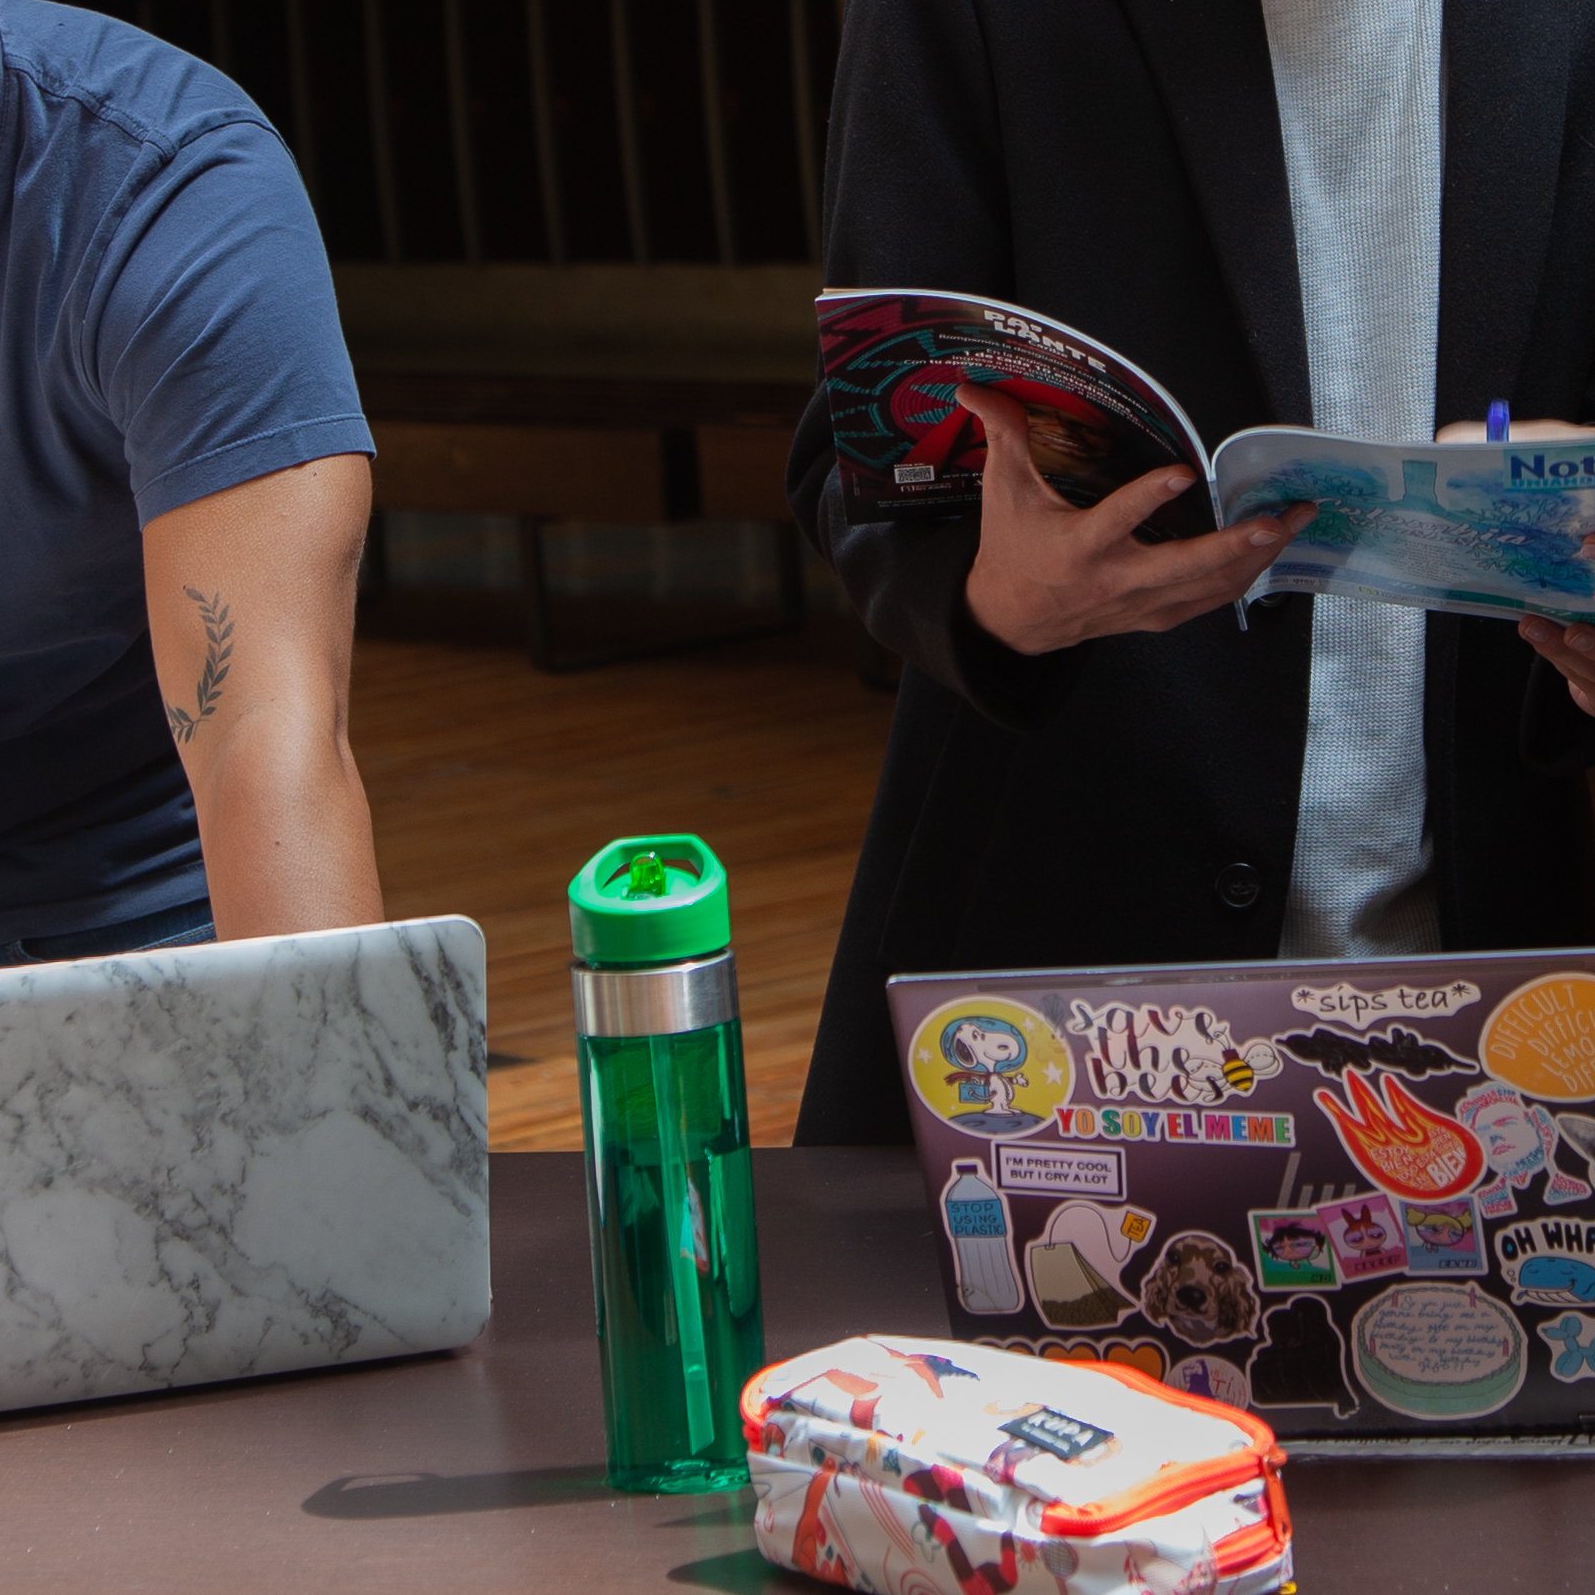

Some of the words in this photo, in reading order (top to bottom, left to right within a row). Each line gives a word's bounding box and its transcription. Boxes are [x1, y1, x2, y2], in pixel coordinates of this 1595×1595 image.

[1072, 1004, 1214, 1045] save
[1490, 984, 1576, 1060] DIFFICULT
[1056, 1108, 1094, 1135] YO
[1102, 1109, 1161, 1138] SOY
[1167, 1113, 1199, 1139] EL
[1205, 1114, 1292, 1144] MEME
[1005, 1157, 1023, 1167] I'M
[1026, 1159, 1074, 1170] PRETTY
[1076, 1162, 1112, 1173] COOL
[1426, 1146, 1467, 1189] BIEN
[1010, 1170, 1034, 1180] BUT
[1044, 1172, 1069, 1182] CRY
[1072, 1173, 1082, 1183] A
[1084, 1175, 1108, 1185] LOT
[950, 1204, 994, 1214] STOP
[953, 1215, 997, 1225] USING
[1127, 1217, 1145, 1237] TEA
[954, 1225, 1006, 1236] PLASTIC
[1501, 1225, 1538, 1262] OH
